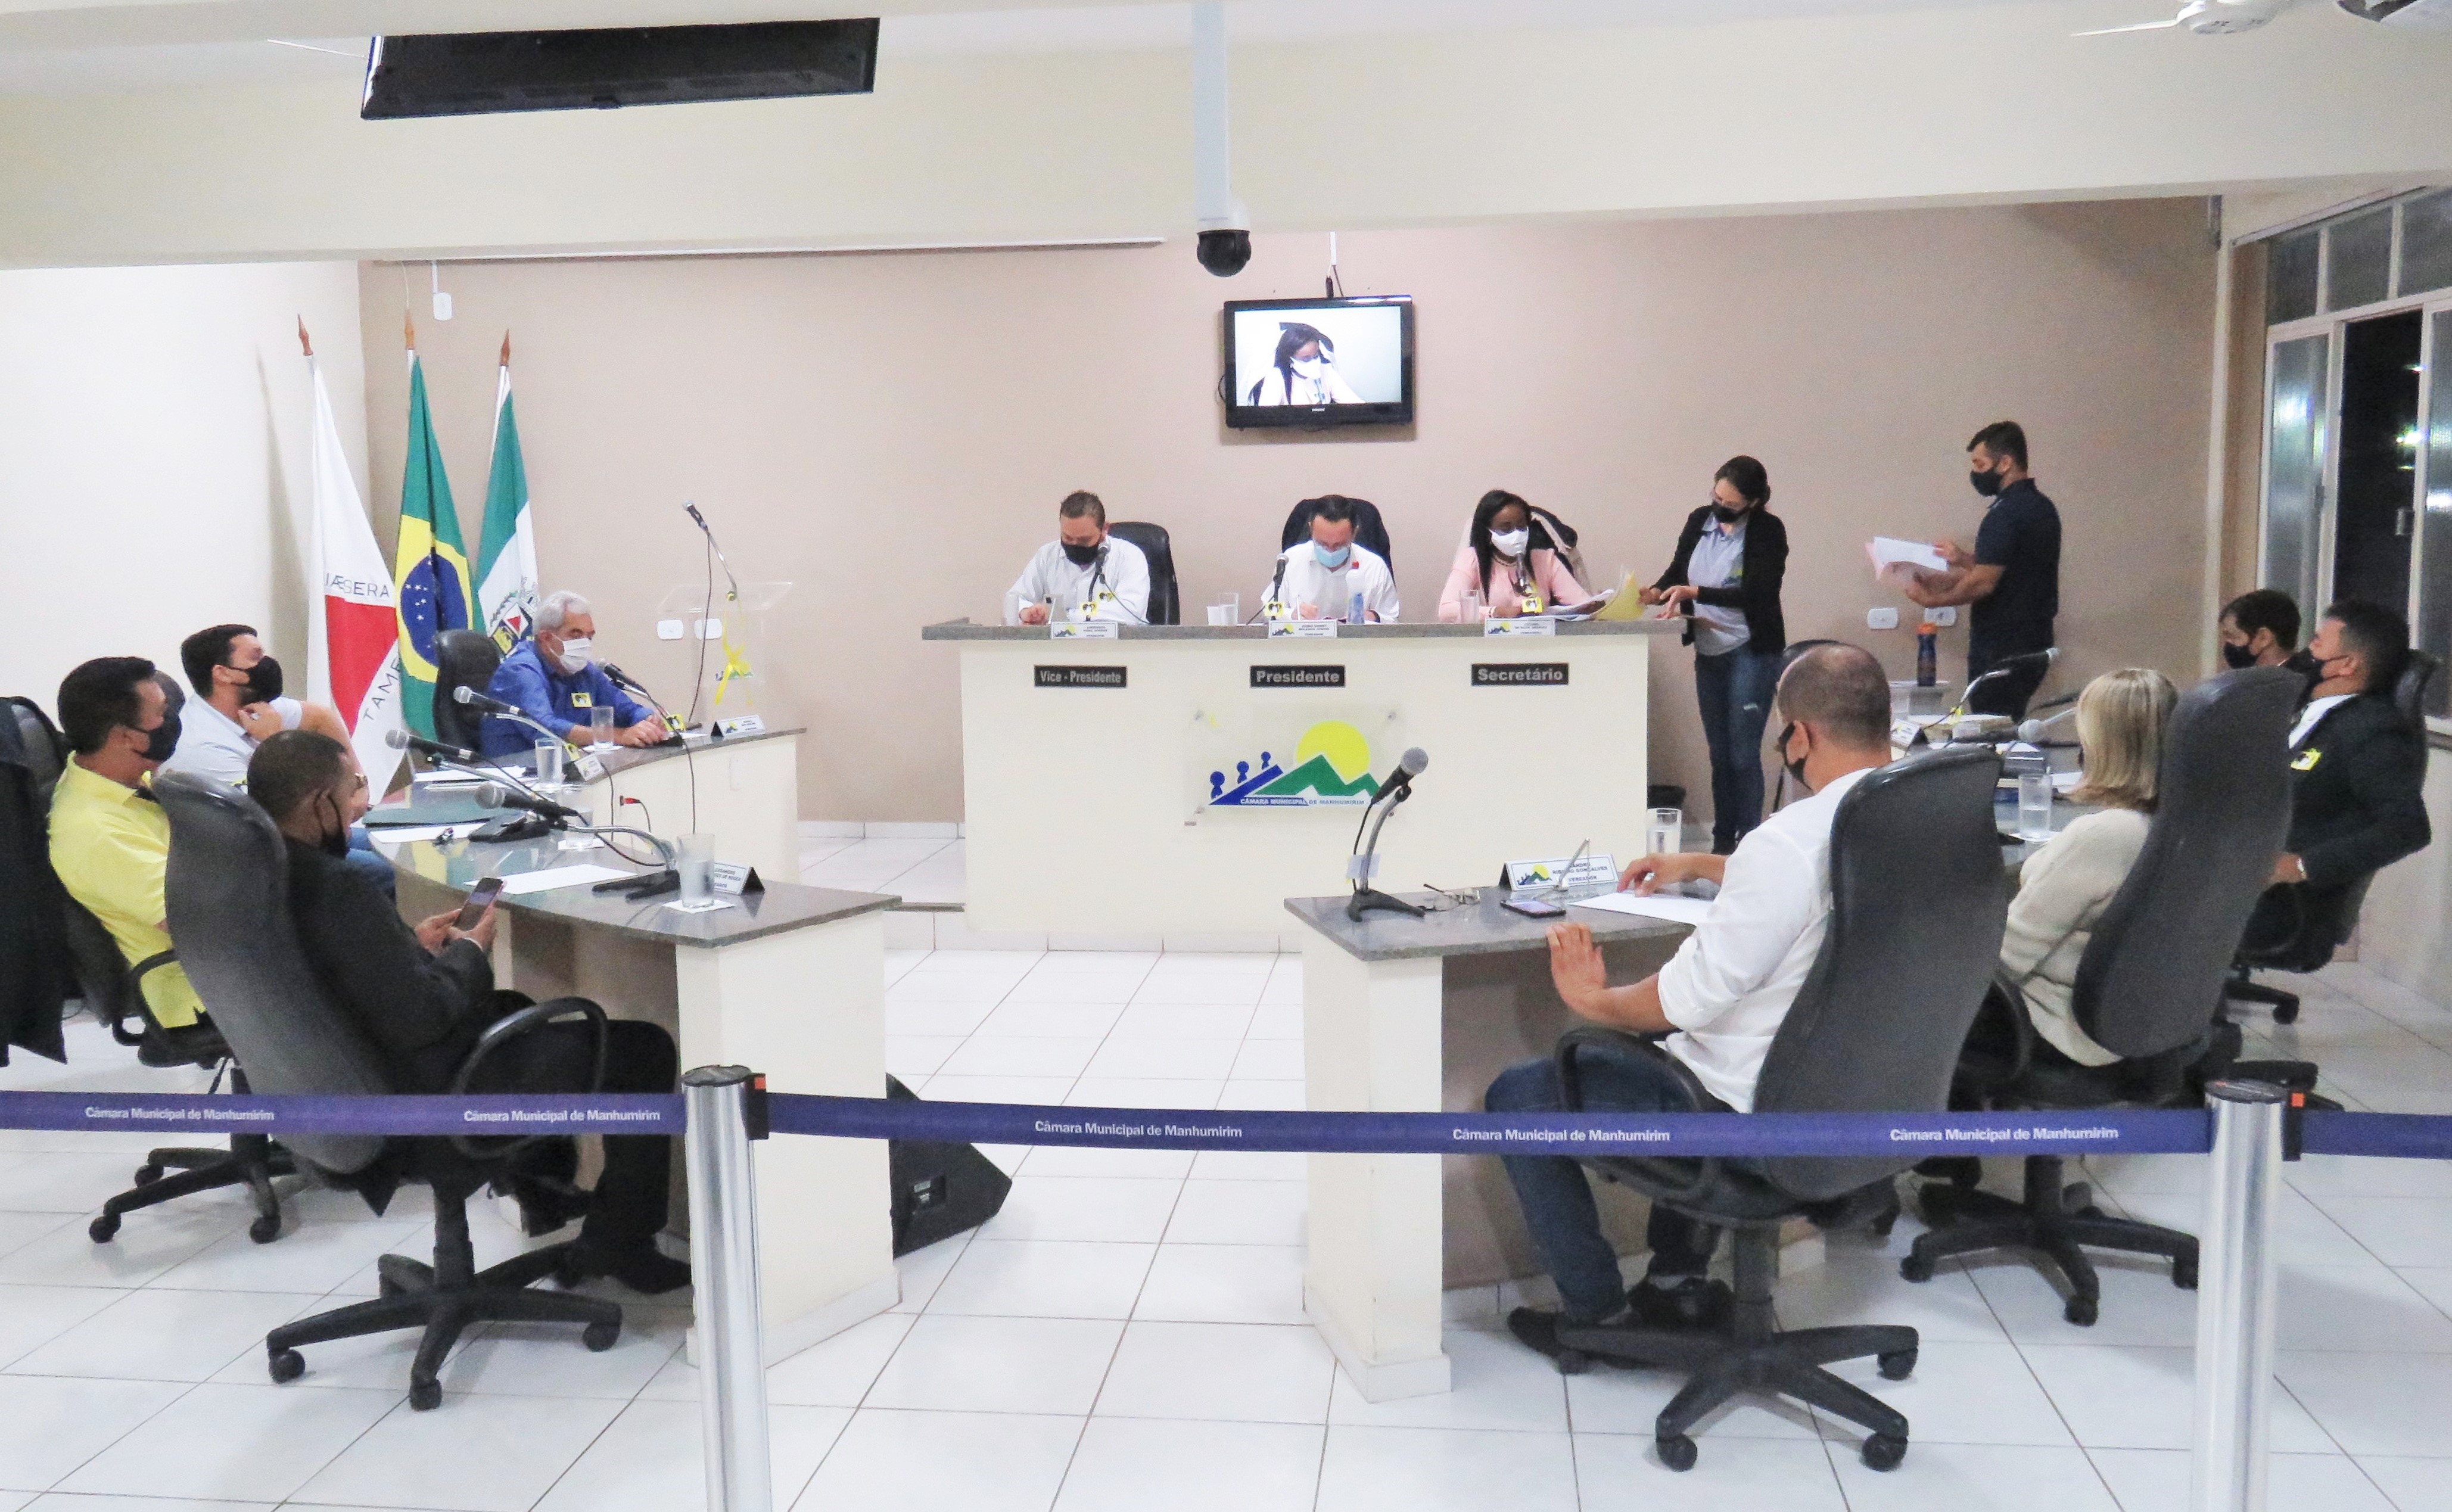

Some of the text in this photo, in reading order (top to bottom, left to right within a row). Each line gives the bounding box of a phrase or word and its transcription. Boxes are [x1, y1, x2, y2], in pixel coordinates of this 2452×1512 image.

[1040, 670, 1062, 682] Vice
[1070, 670, 1121, 683] Presidente
[1256, 670, 1340, 683] Presidente
[1478, 668, 1563, 681] Secretário
[131, 1108, 185, 1121] Municipal
[187, 1109, 201, 1120] de
[203, 1109, 275, 1121] Manhumirim
[463, 1109, 661, 1124] Câmara Municipal de Manhumirim
[1035, 1120, 1242, 1137] Câmara Municipal de Manhumirim
[1452, 1128, 1670, 1143] Câmara Municipal de Manhumirim
[1890, 1126, 2119, 1143] Câmara Municipal de Manhumirim
